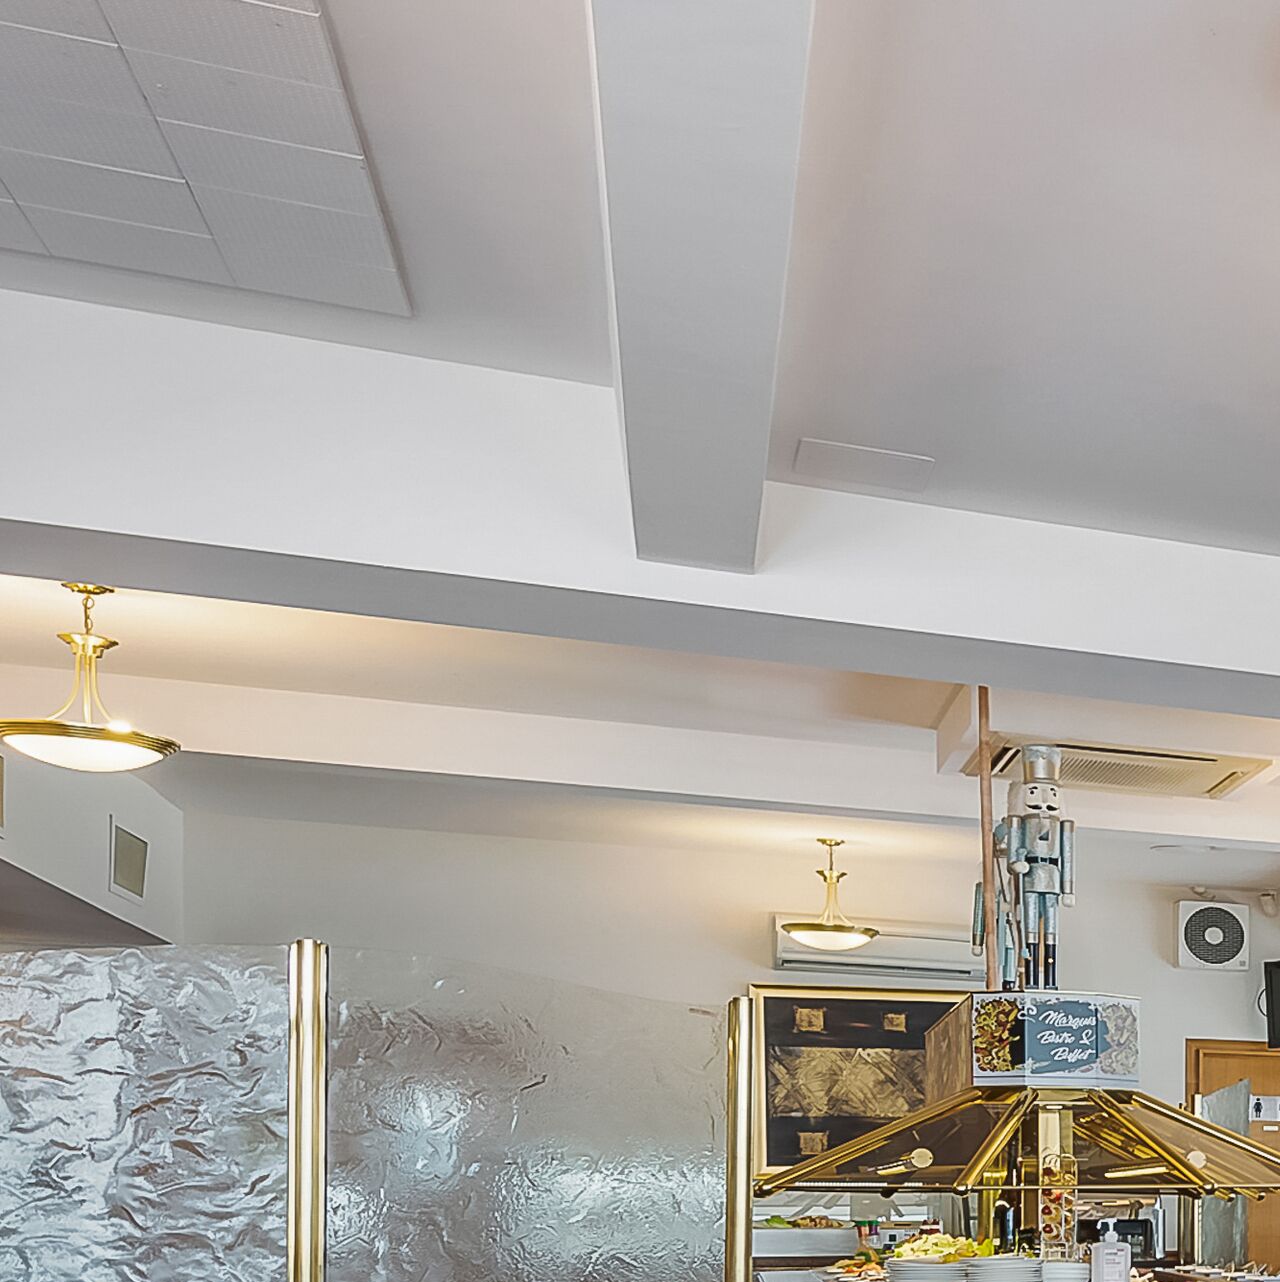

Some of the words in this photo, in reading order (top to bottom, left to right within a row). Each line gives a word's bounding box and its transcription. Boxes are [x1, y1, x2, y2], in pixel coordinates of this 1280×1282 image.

[1037, 1030, 1075, 1044] Bistro
[1079, 1029, 1096, 1045] &
[1050, 1046, 1096, 1063] Buffet
